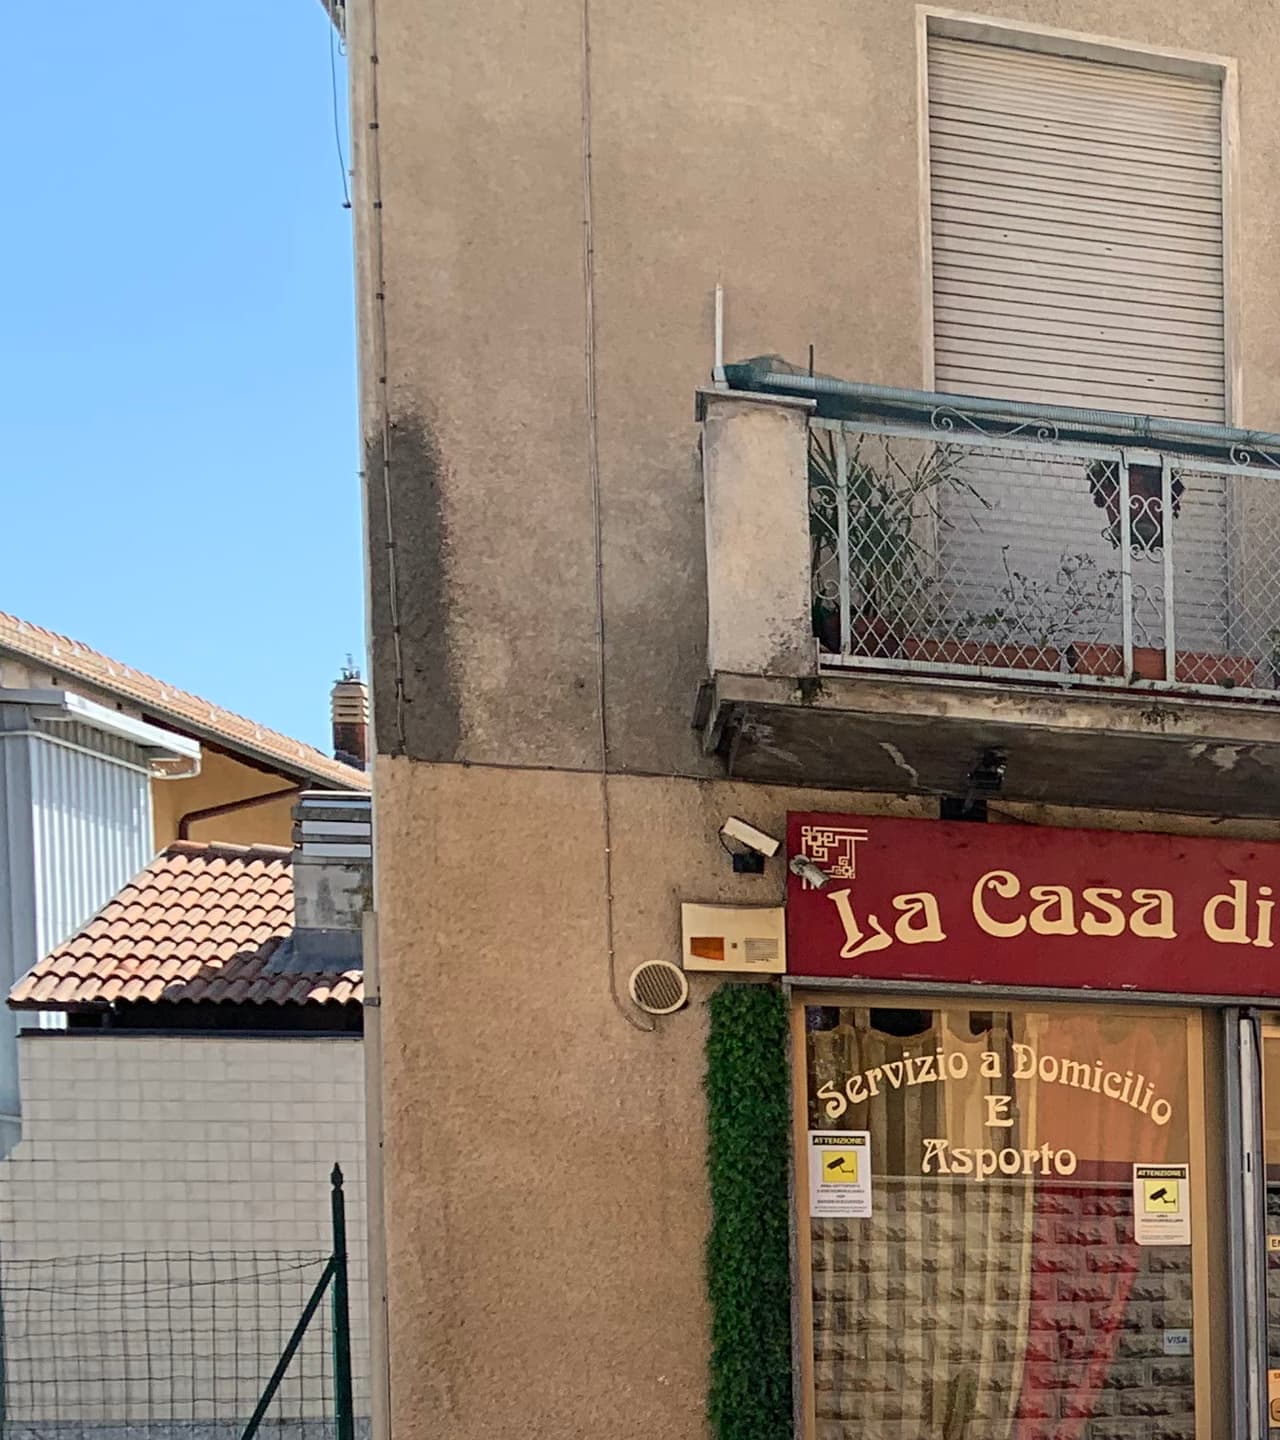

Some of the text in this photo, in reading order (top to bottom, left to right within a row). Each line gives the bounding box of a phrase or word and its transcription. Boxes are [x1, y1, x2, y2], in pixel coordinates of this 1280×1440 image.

[828, 888, 947, 959] La
[972, 870, 1178, 939] Casa
[1203, 879, 1275, 948] di
[817, 1043, 1172, 1126] Servizio a Domicilio
[984, 1095, 1014, 1127] E
[921, 1138, 1078, 1182] Asporto
[1167, 1335, 1188, 1344] VISA
